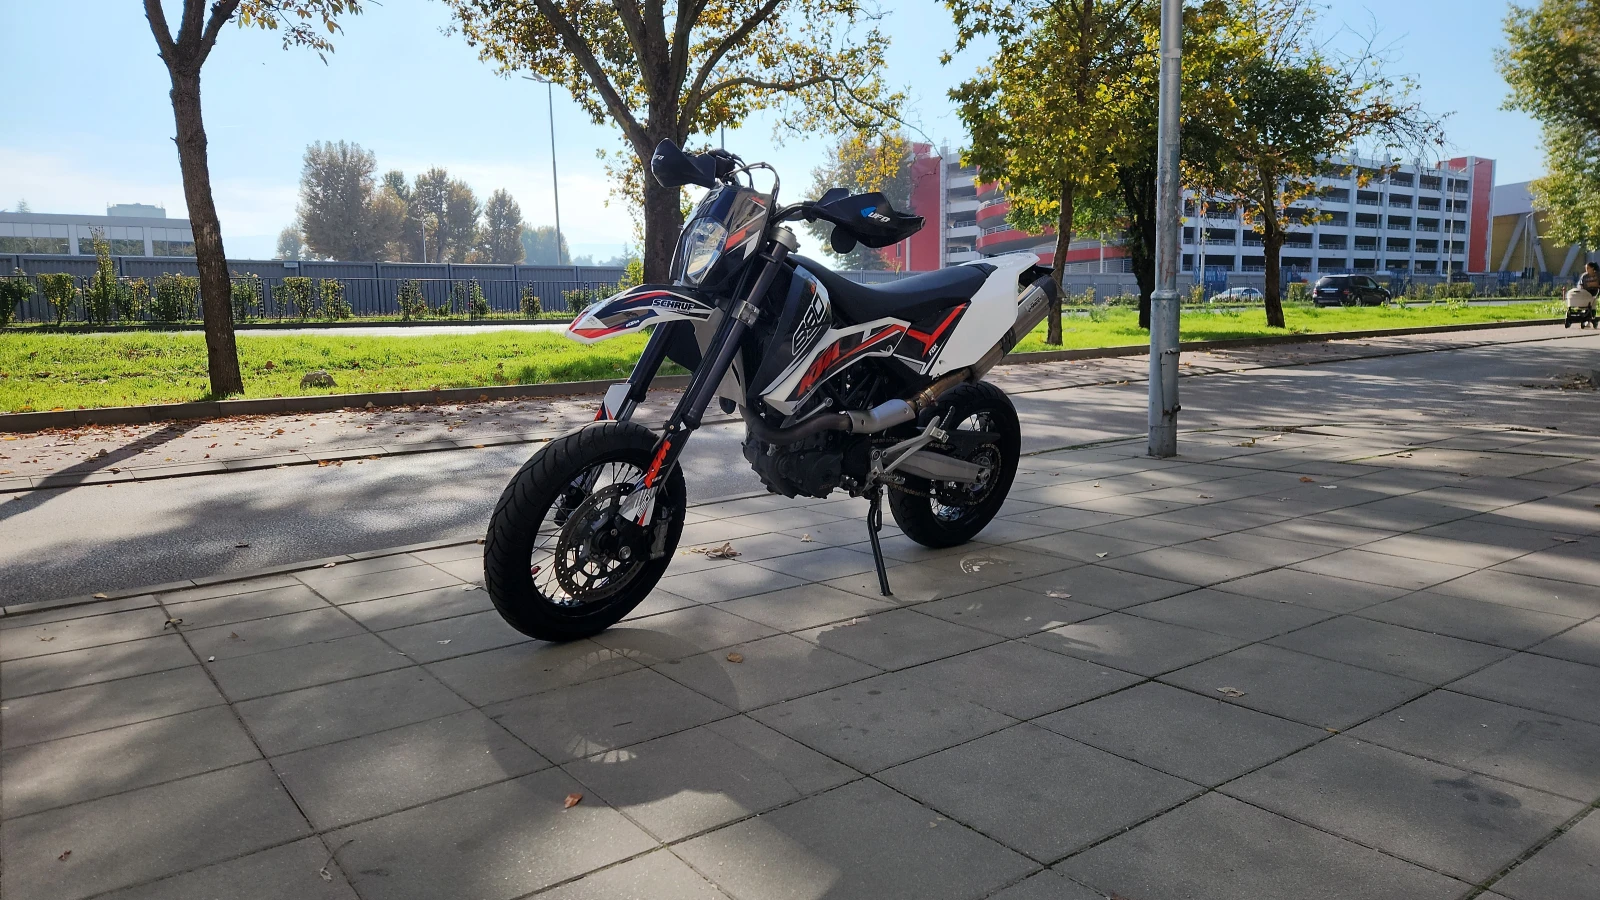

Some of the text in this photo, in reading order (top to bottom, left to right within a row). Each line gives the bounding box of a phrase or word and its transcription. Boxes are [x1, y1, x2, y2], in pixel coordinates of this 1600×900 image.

[868, 212, 890, 222] UFO
[797, 340, 840, 397] KTM
[644, 440, 671, 489] KTM
